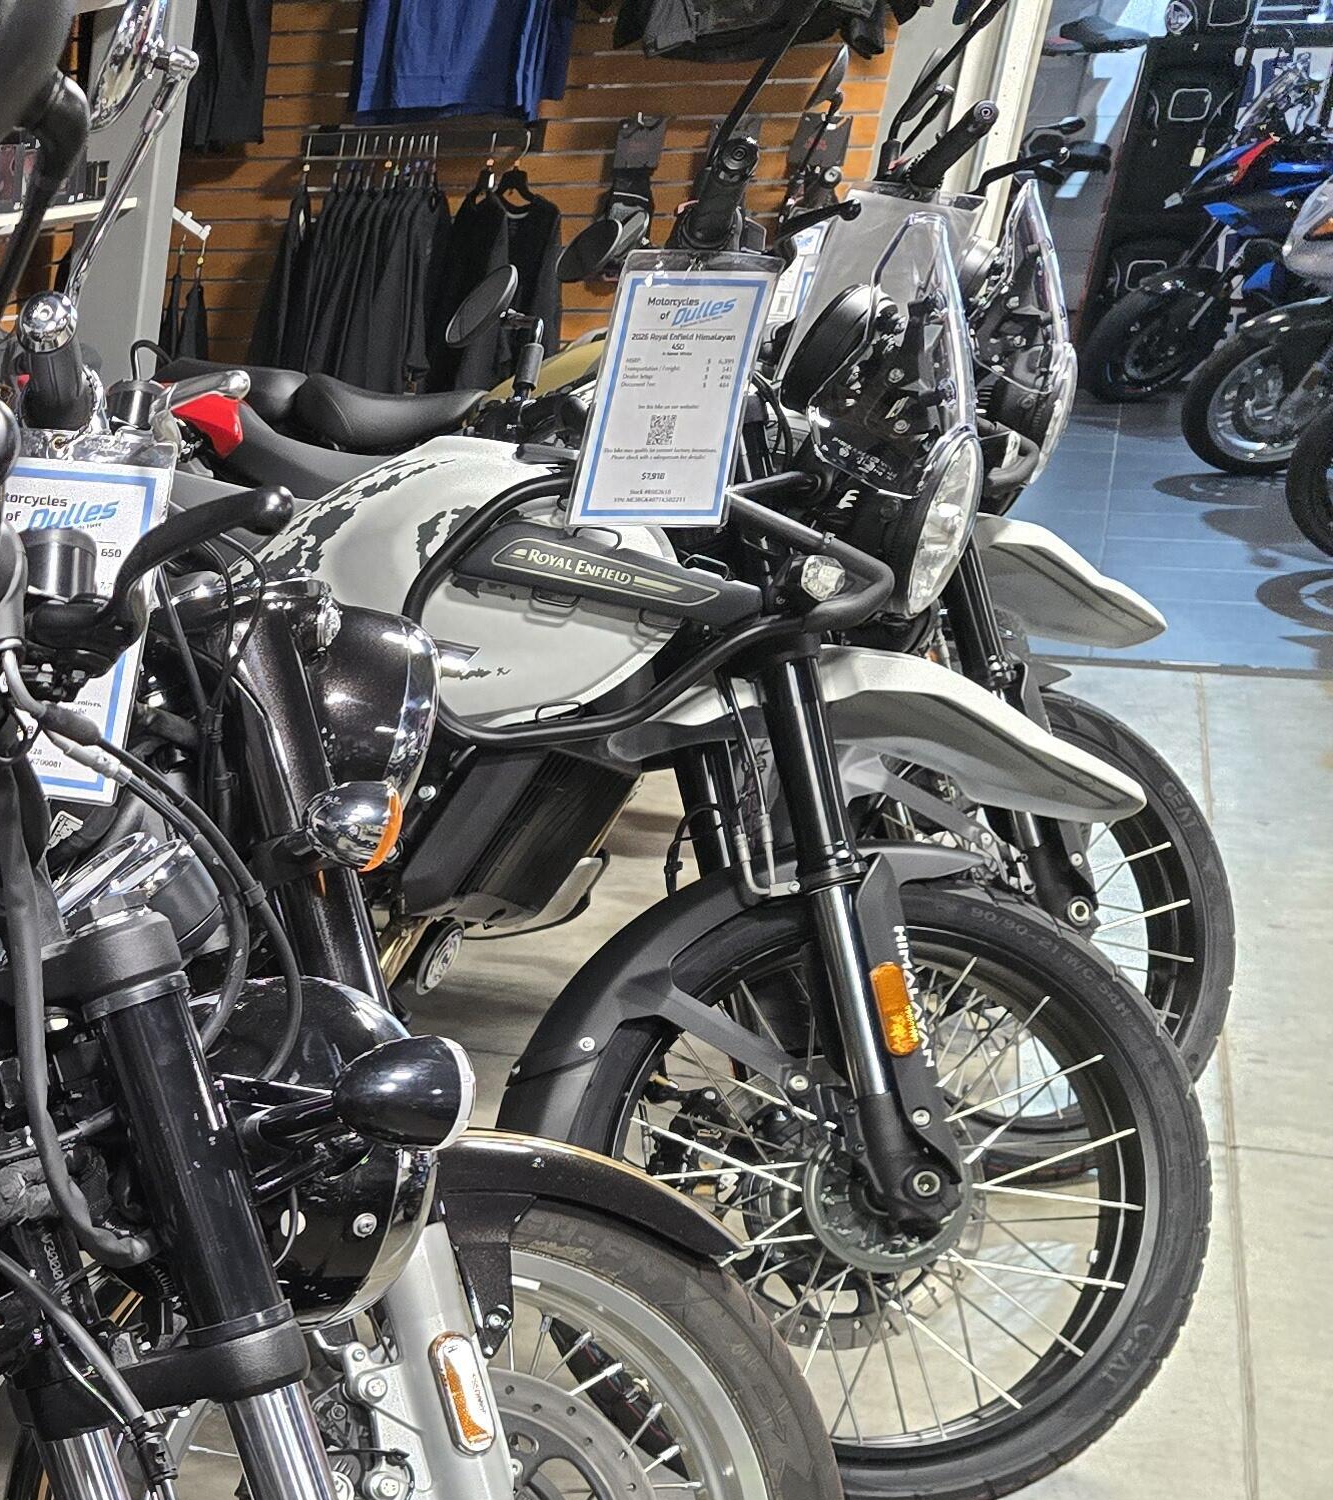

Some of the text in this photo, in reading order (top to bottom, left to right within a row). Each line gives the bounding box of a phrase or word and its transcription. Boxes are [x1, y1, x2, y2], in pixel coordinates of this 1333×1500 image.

[648, 297, 699, 307] Motorcycles
[660, 311, 669, 320] of
[672, 298, 737, 326] Dulles
[696, 334, 736, 342] Himalayan
[5, 493, 68, 507] torcycles
[6, 501, 121, 529] of Dulles
[100, 549, 122, 557] 650
[528, 548, 632, 585] ROYAL ENFIELD
[893, 925, 935, 1067] HIMALAYAN
